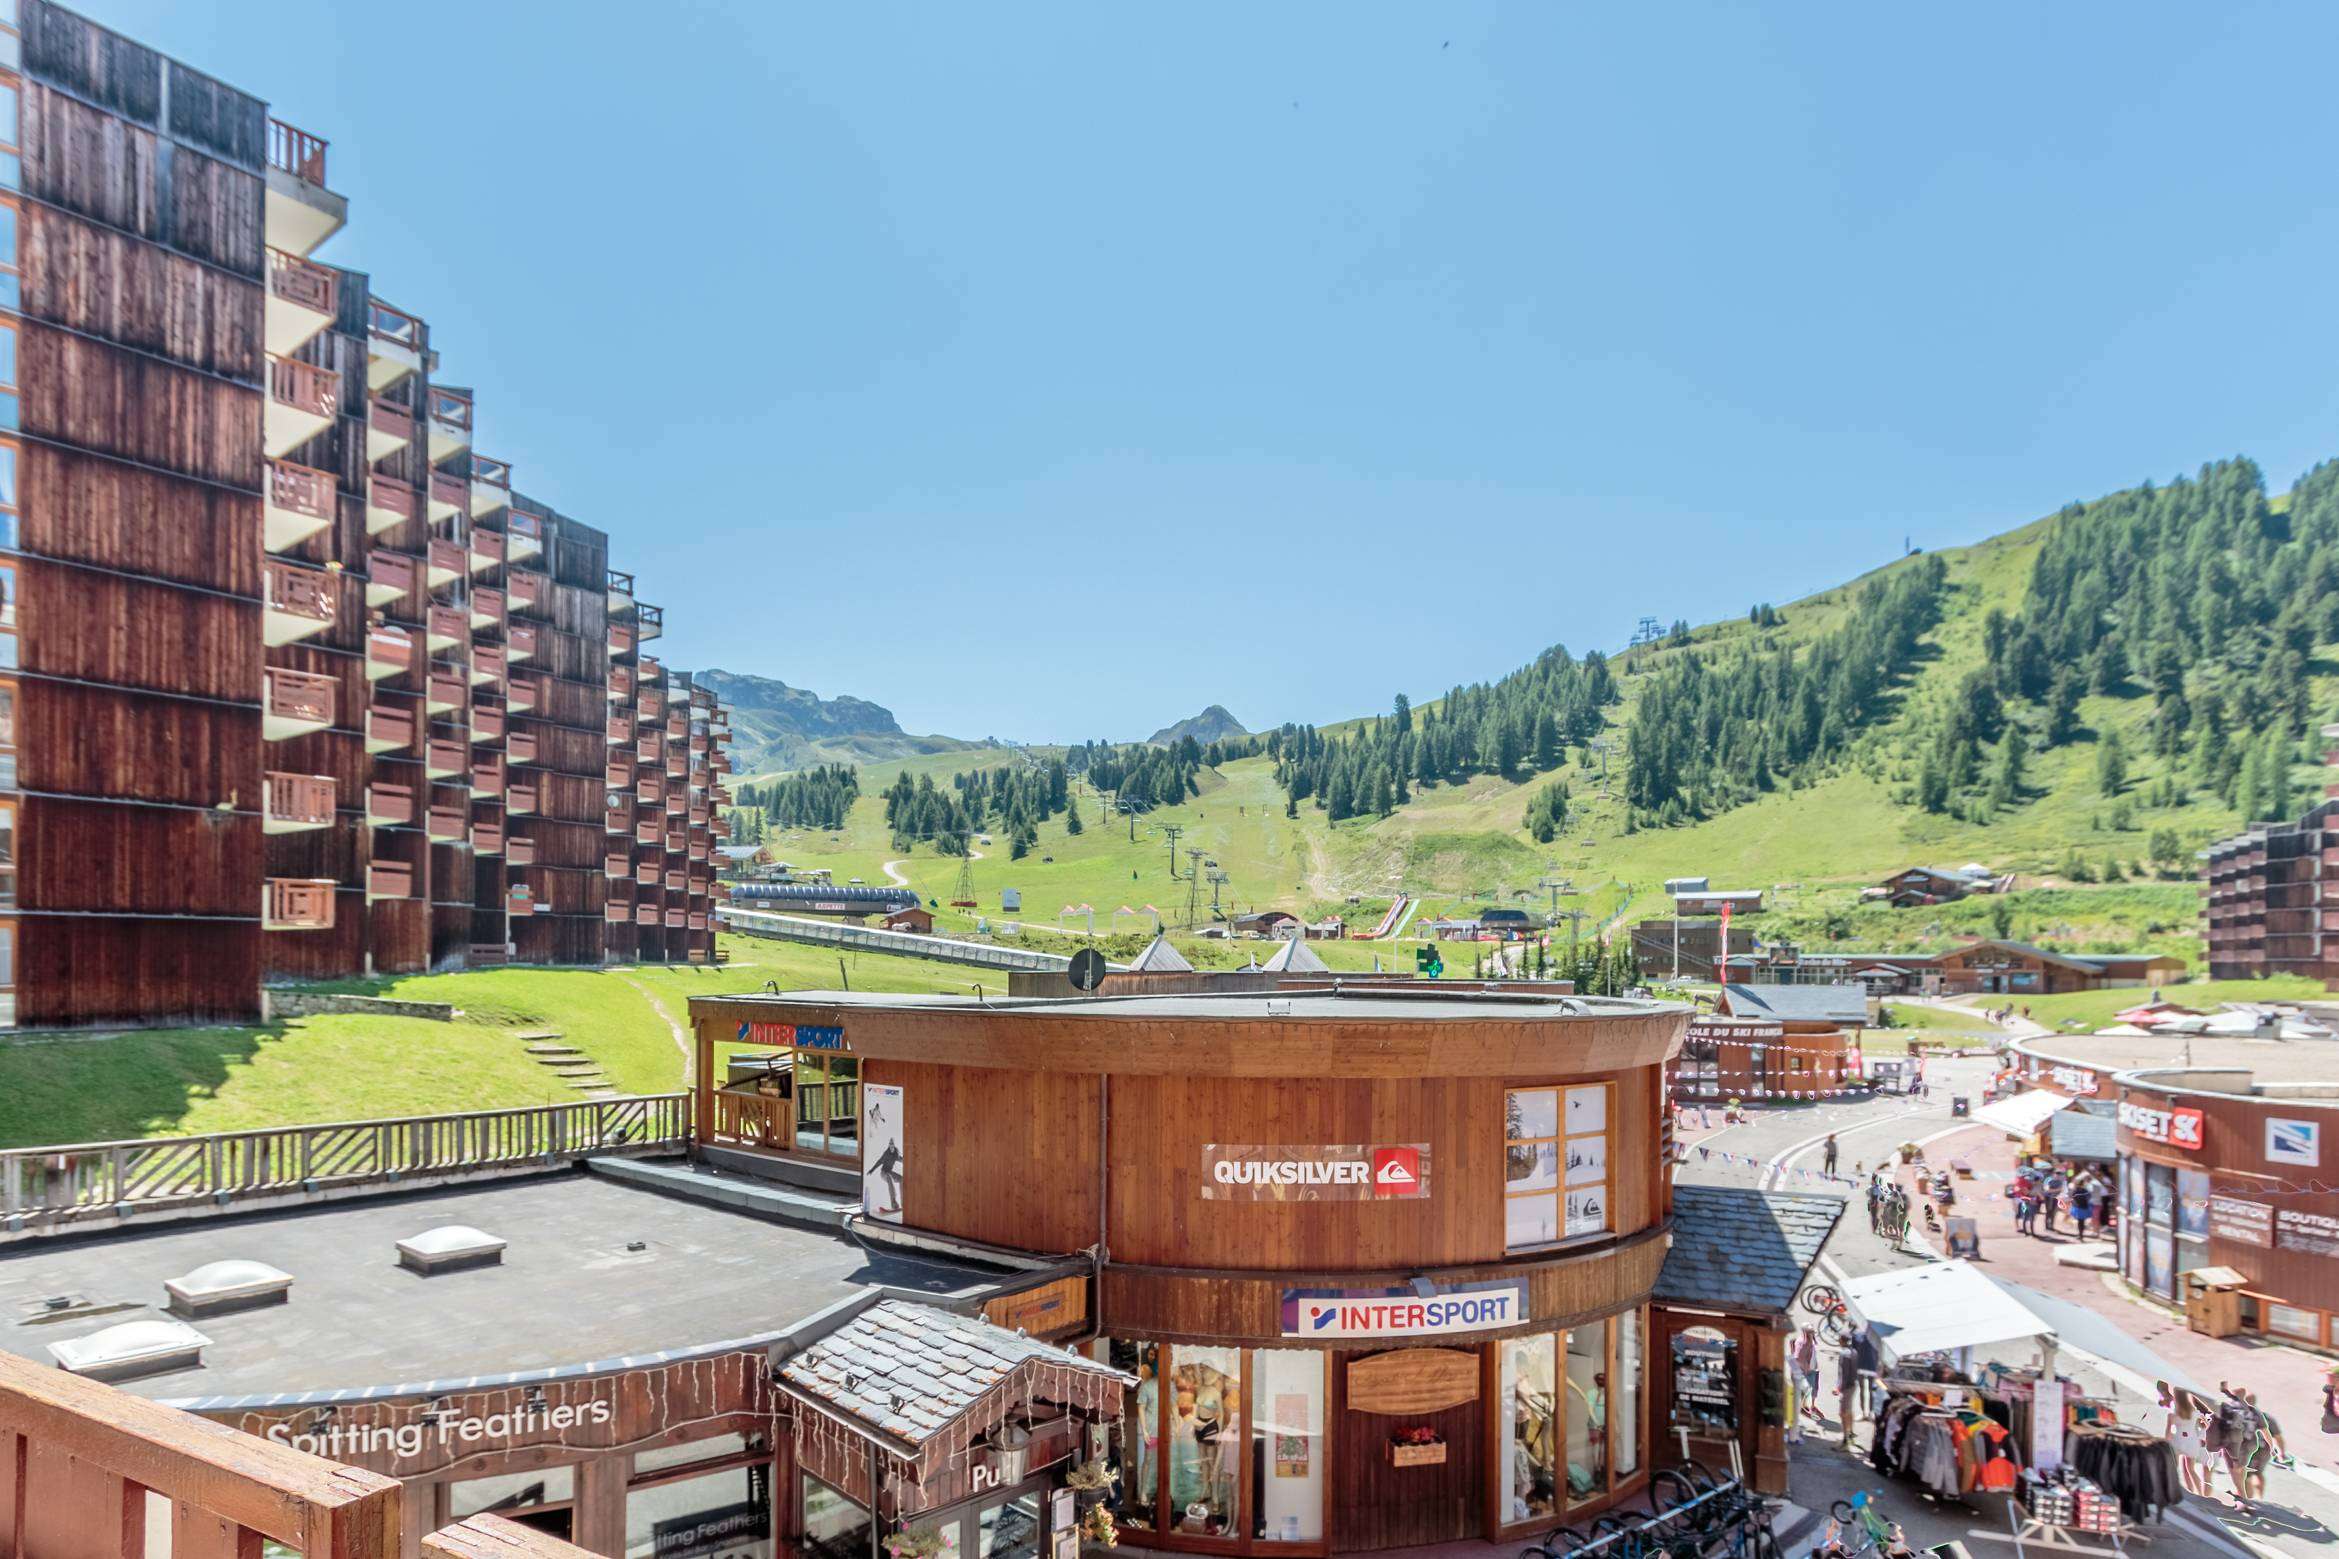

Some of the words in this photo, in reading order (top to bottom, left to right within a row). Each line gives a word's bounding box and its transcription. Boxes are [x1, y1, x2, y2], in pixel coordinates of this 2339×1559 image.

[752, 1023, 845, 1048] INTERSPORT
[1713, 1027, 1730, 1037] DU
[1732, 1027, 1751, 1037] SKI
[873, 1087, 899, 1096] INTERSPORT
[2118, 1101, 2173, 1135] SKISET
[1214, 1160, 1370, 1184] QUIKSILVER
[2213, 1200, 2268, 1219] LOCATION
[2217, 1224, 2262, 1242] RENTAL
[1341, 1296, 1510, 1330] INTERSPORT
[267, 1421, 423, 1458] Spitting
[437, 1397, 611, 1445] Feathers
[972, 1465, 1002, 1492] Pu
[697, 1511, 768, 1538] Feathers
